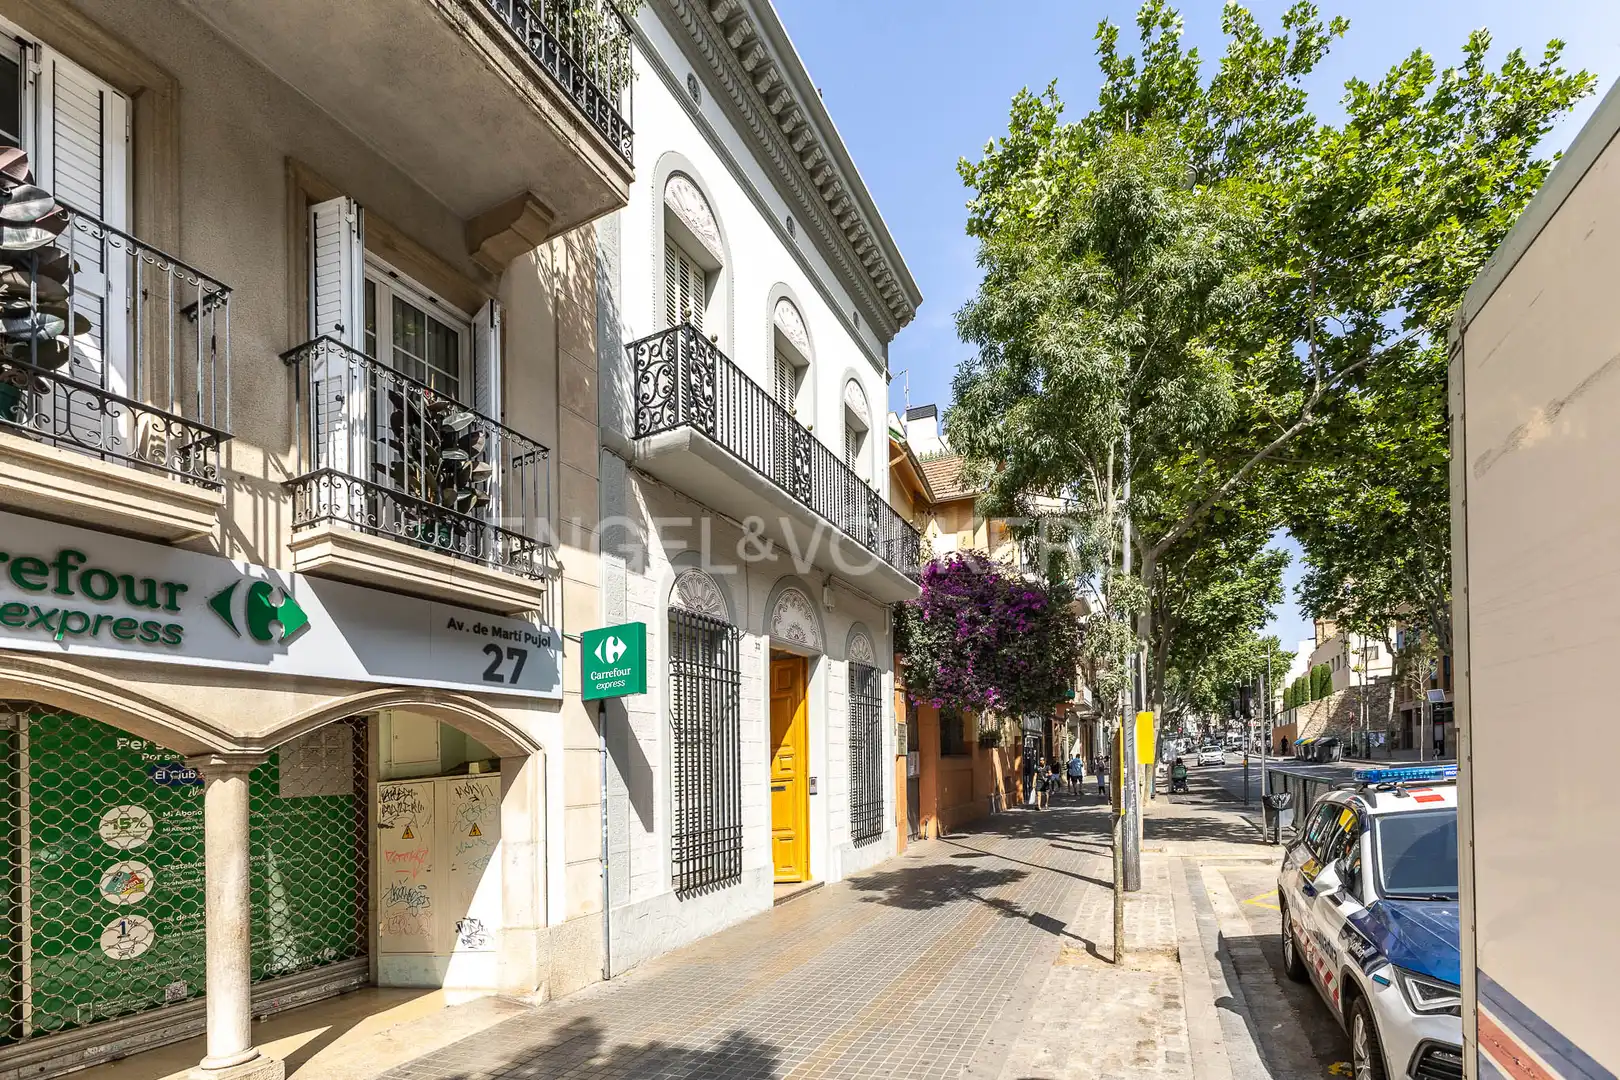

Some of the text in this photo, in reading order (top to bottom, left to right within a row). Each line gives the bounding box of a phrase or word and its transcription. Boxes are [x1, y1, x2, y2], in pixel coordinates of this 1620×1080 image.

[0, 550, 188, 611] efour
[0, 602, 184, 645] express
[472, 622, 489, 636] de
[491, 626, 522, 642] Martí
[523, 632, 551, 649] Pujol
[482, 643, 528, 684] 27
[590, 667, 632, 681] Carrefour
[595, 679, 626, 691] express
[155, 769, 166, 780] El
[169, 769, 197, 780] Club
